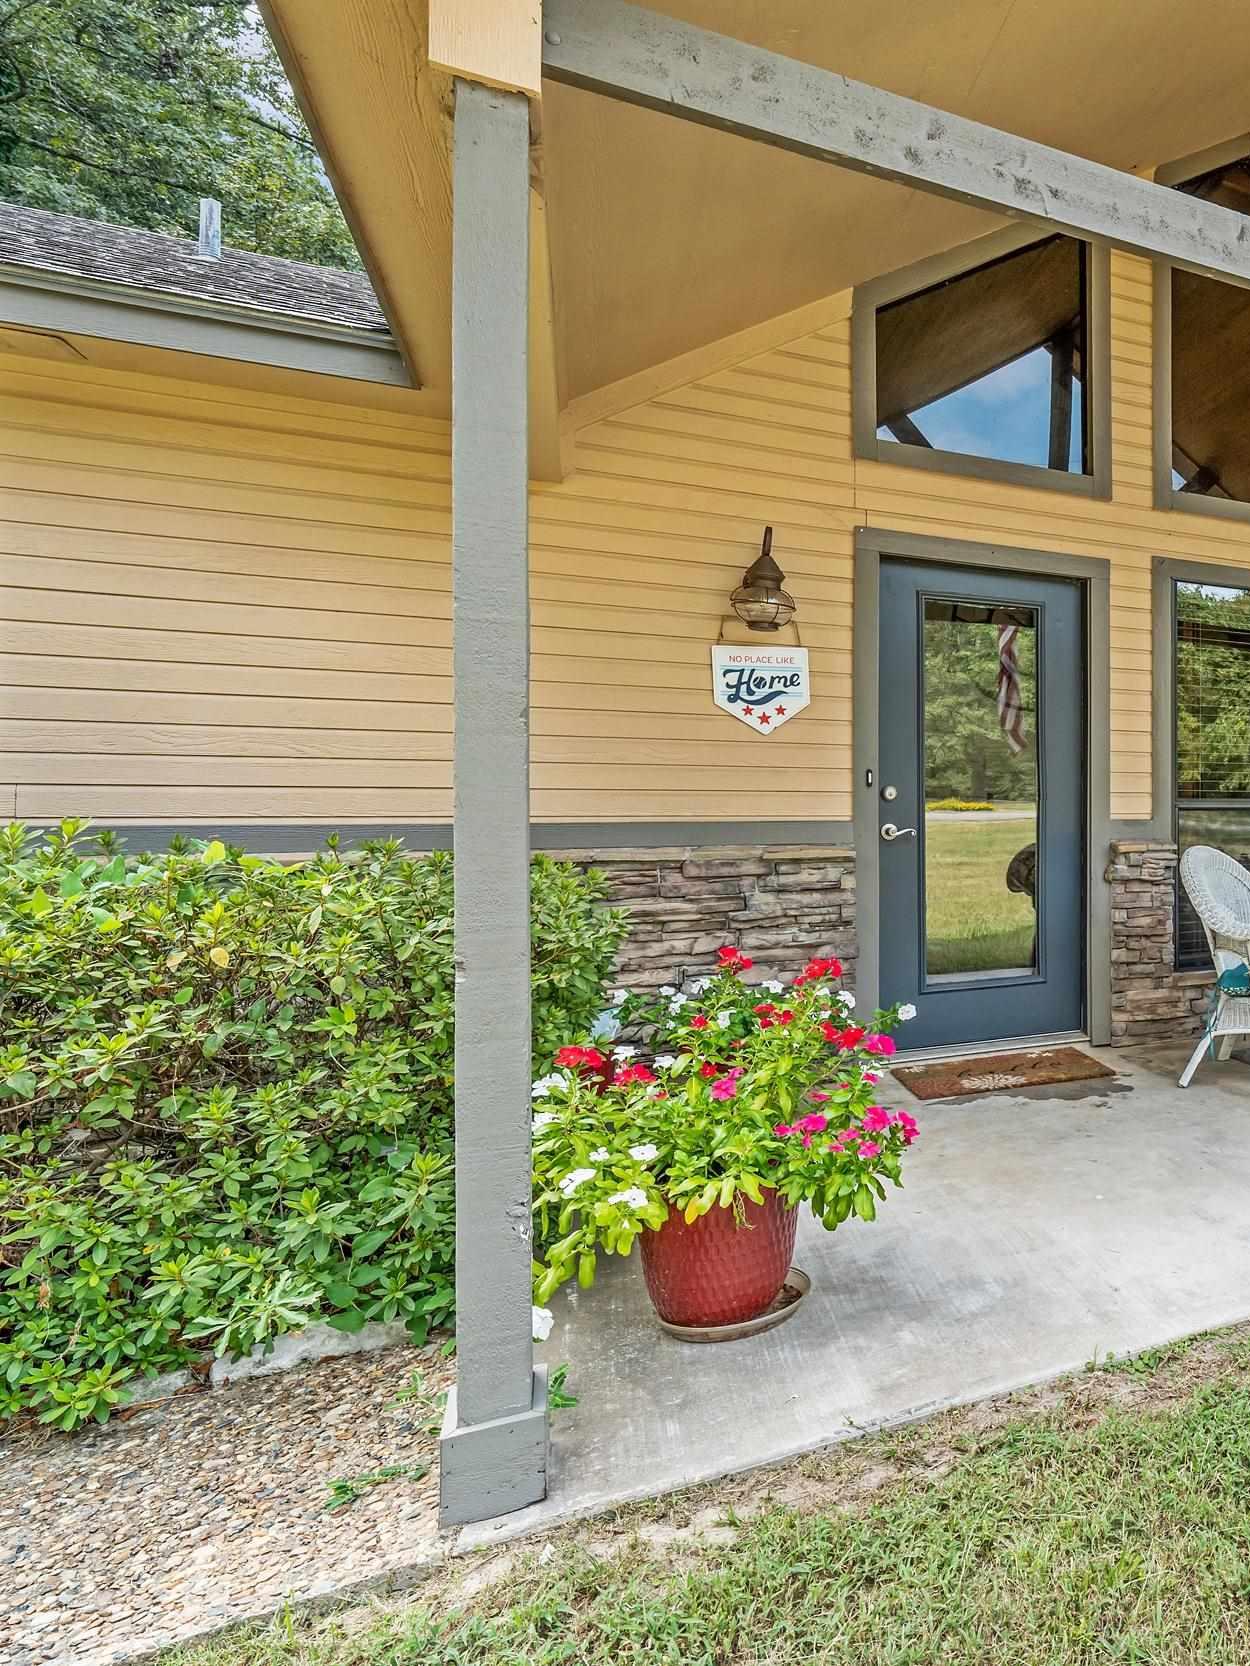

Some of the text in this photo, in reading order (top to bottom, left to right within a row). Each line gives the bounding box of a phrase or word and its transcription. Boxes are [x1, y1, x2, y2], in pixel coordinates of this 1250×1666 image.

[729, 655, 796, 664] NO PLACE LIKE
[722, 668, 801, 705] Home
